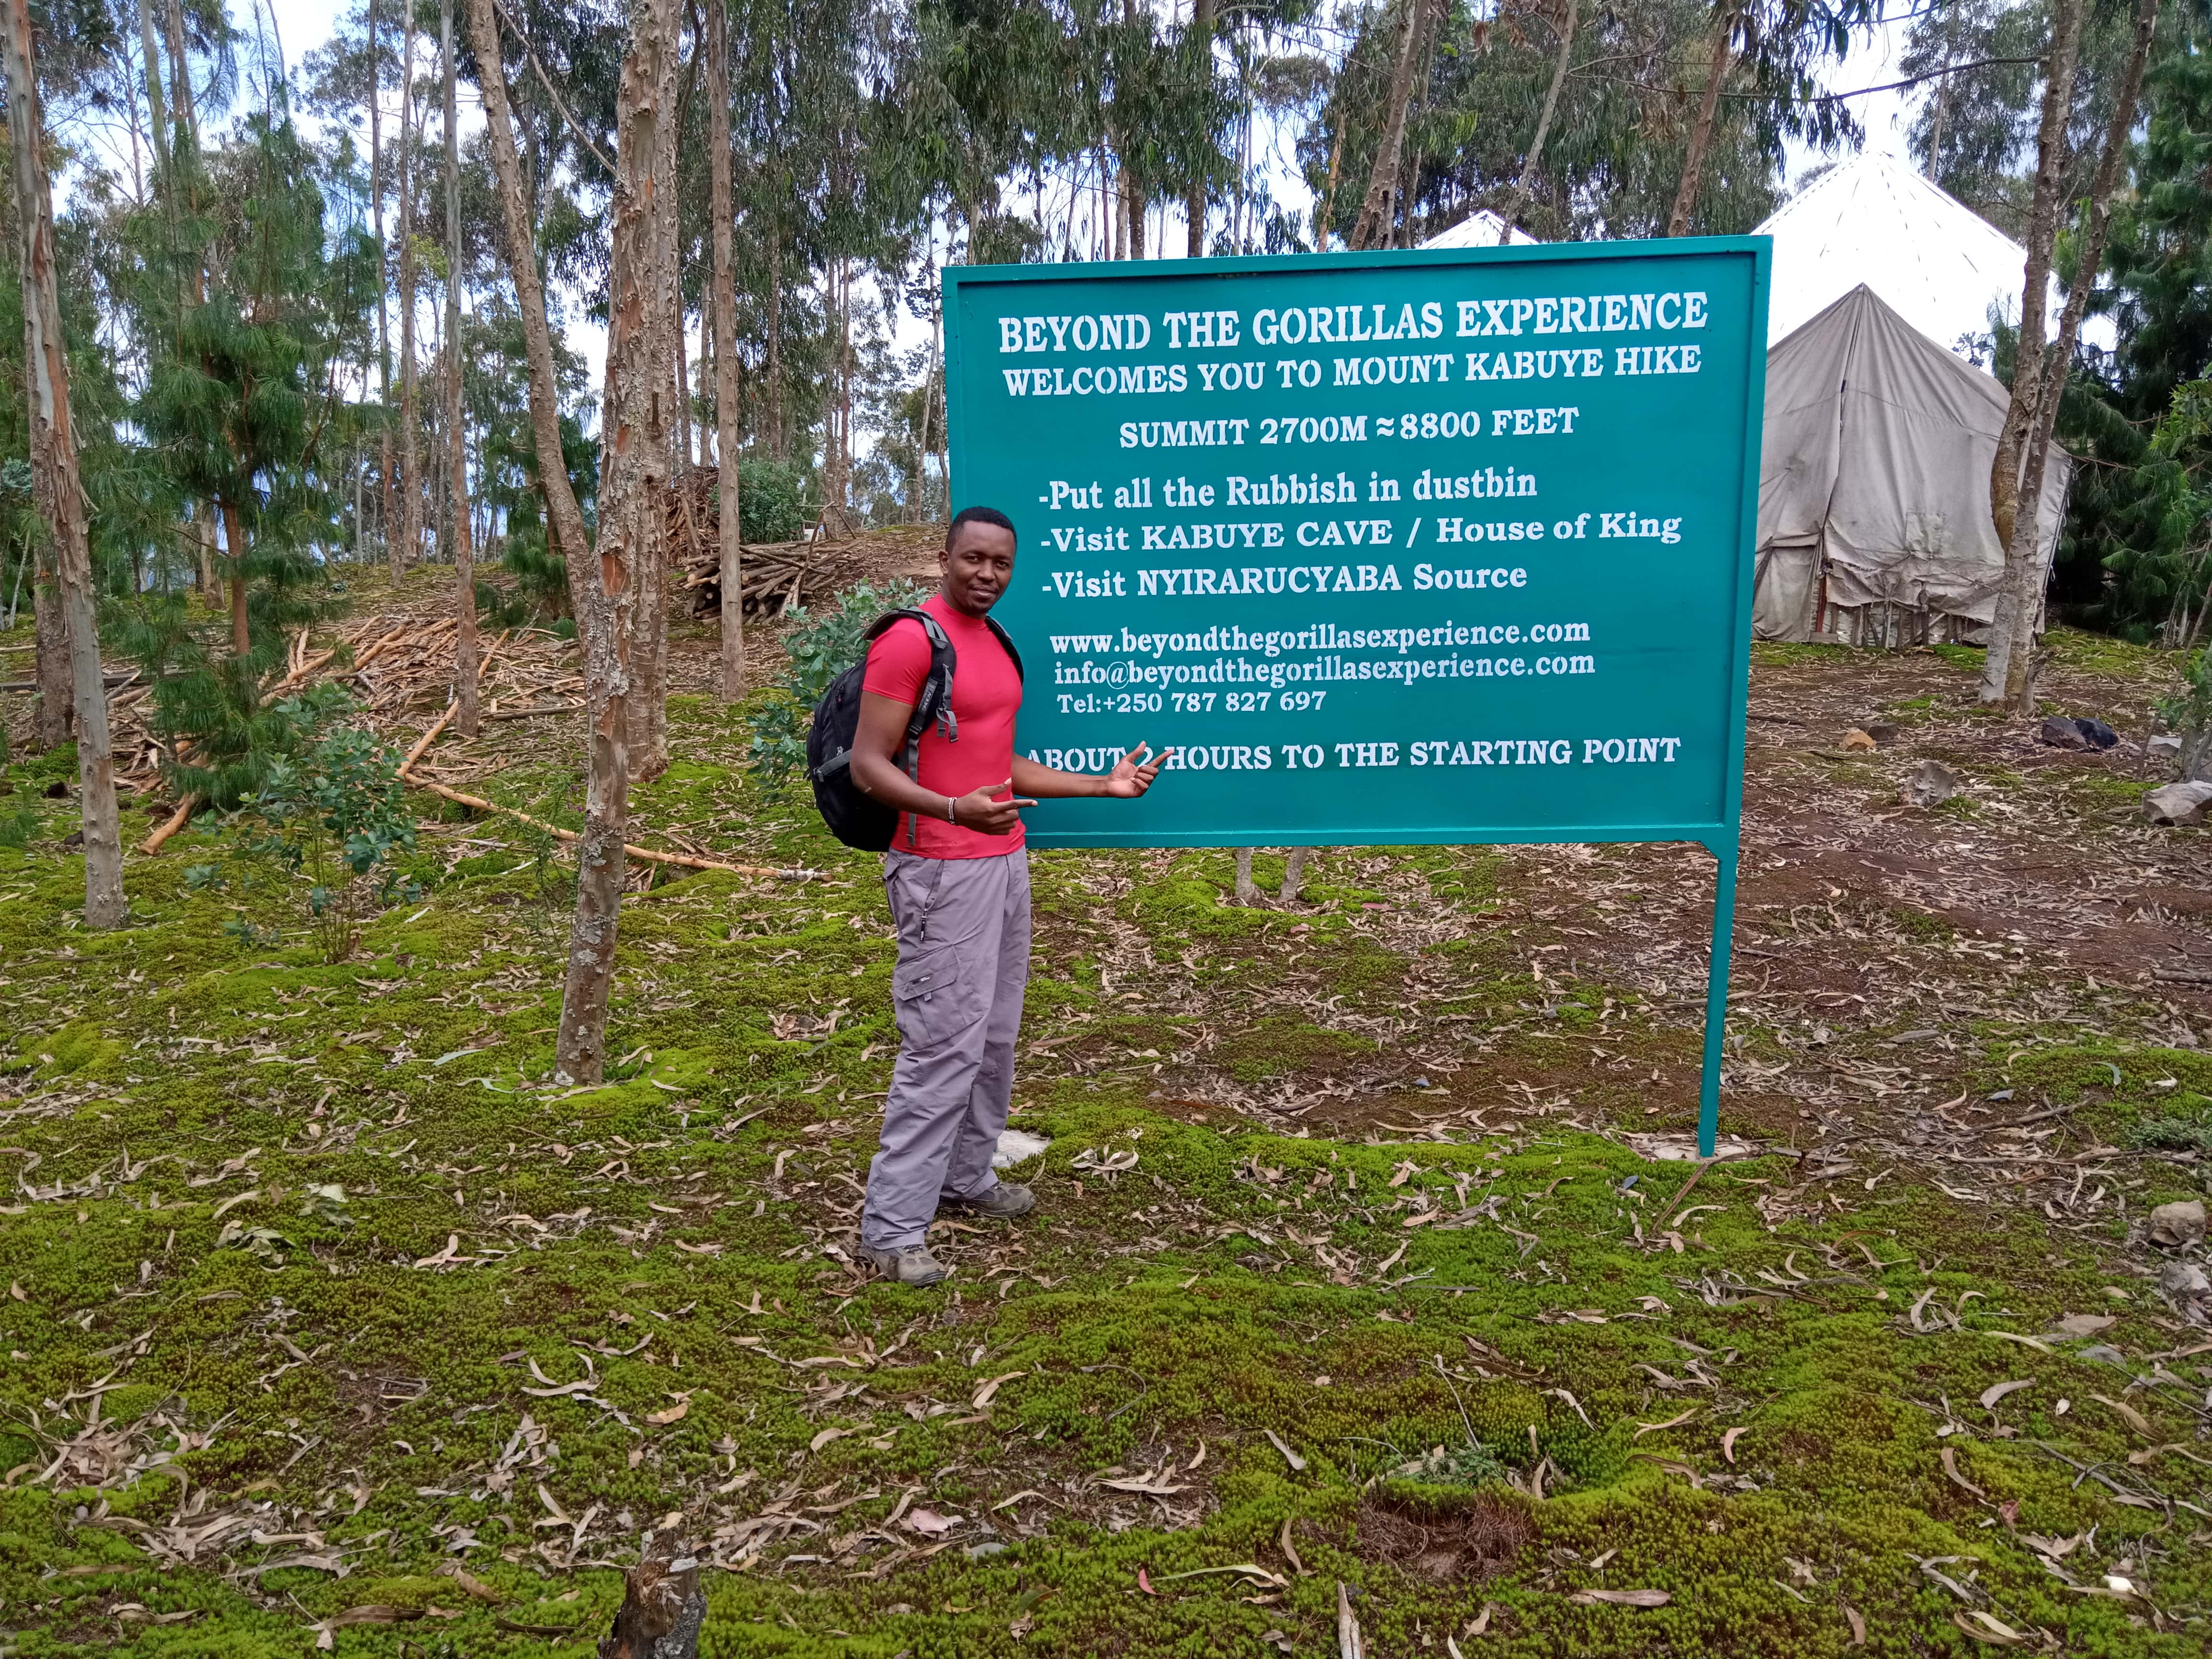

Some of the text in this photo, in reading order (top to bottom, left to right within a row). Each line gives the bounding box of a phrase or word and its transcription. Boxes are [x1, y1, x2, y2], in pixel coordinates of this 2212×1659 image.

[999, 292, 1707, 352] BEYOND THE GORILLAS EXPERIENCE
[1003, 345, 1701, 396] WELCOMES YOU TO MOUNT KABUYE HIKE
[1120, 419, 1249, 447] SUMMIT
[1261, 416, 1367, 444] 2700M
[1492, 407, 1579, 435] FEET
[1039, 467, 1537, 509] -Put all the Rubbish in dustbin
[1041, 527, 1129, 551] -Visit
[1142, 523, 1284, 549] KABUYE
[1297, 520, 1392, 546] CAVE
[1437, 518, 1544, 542] House
[1554, 513, 1590, 539] of
[1599, 512, 1682, 543] King
[1043, 564, 1527, 597] -Visit NYIRARUCYABA Source
[1050, 620, 1590, 657] www.beyondthegorillasexperience.com
[1055, 653, 1595, 689] info@beyondthegorillasexperience.com
[1057, 691, 1326, 713] Tel:+250 787 827 697
[1164, 745, 1272, 770] HOURS
[1282, 745, 1324, 768] TO
[1335, 743, 1399, 767] THE
[1410, 740, 1572, 765] STARTING
[1583, 738, 1681, 763] POINT
